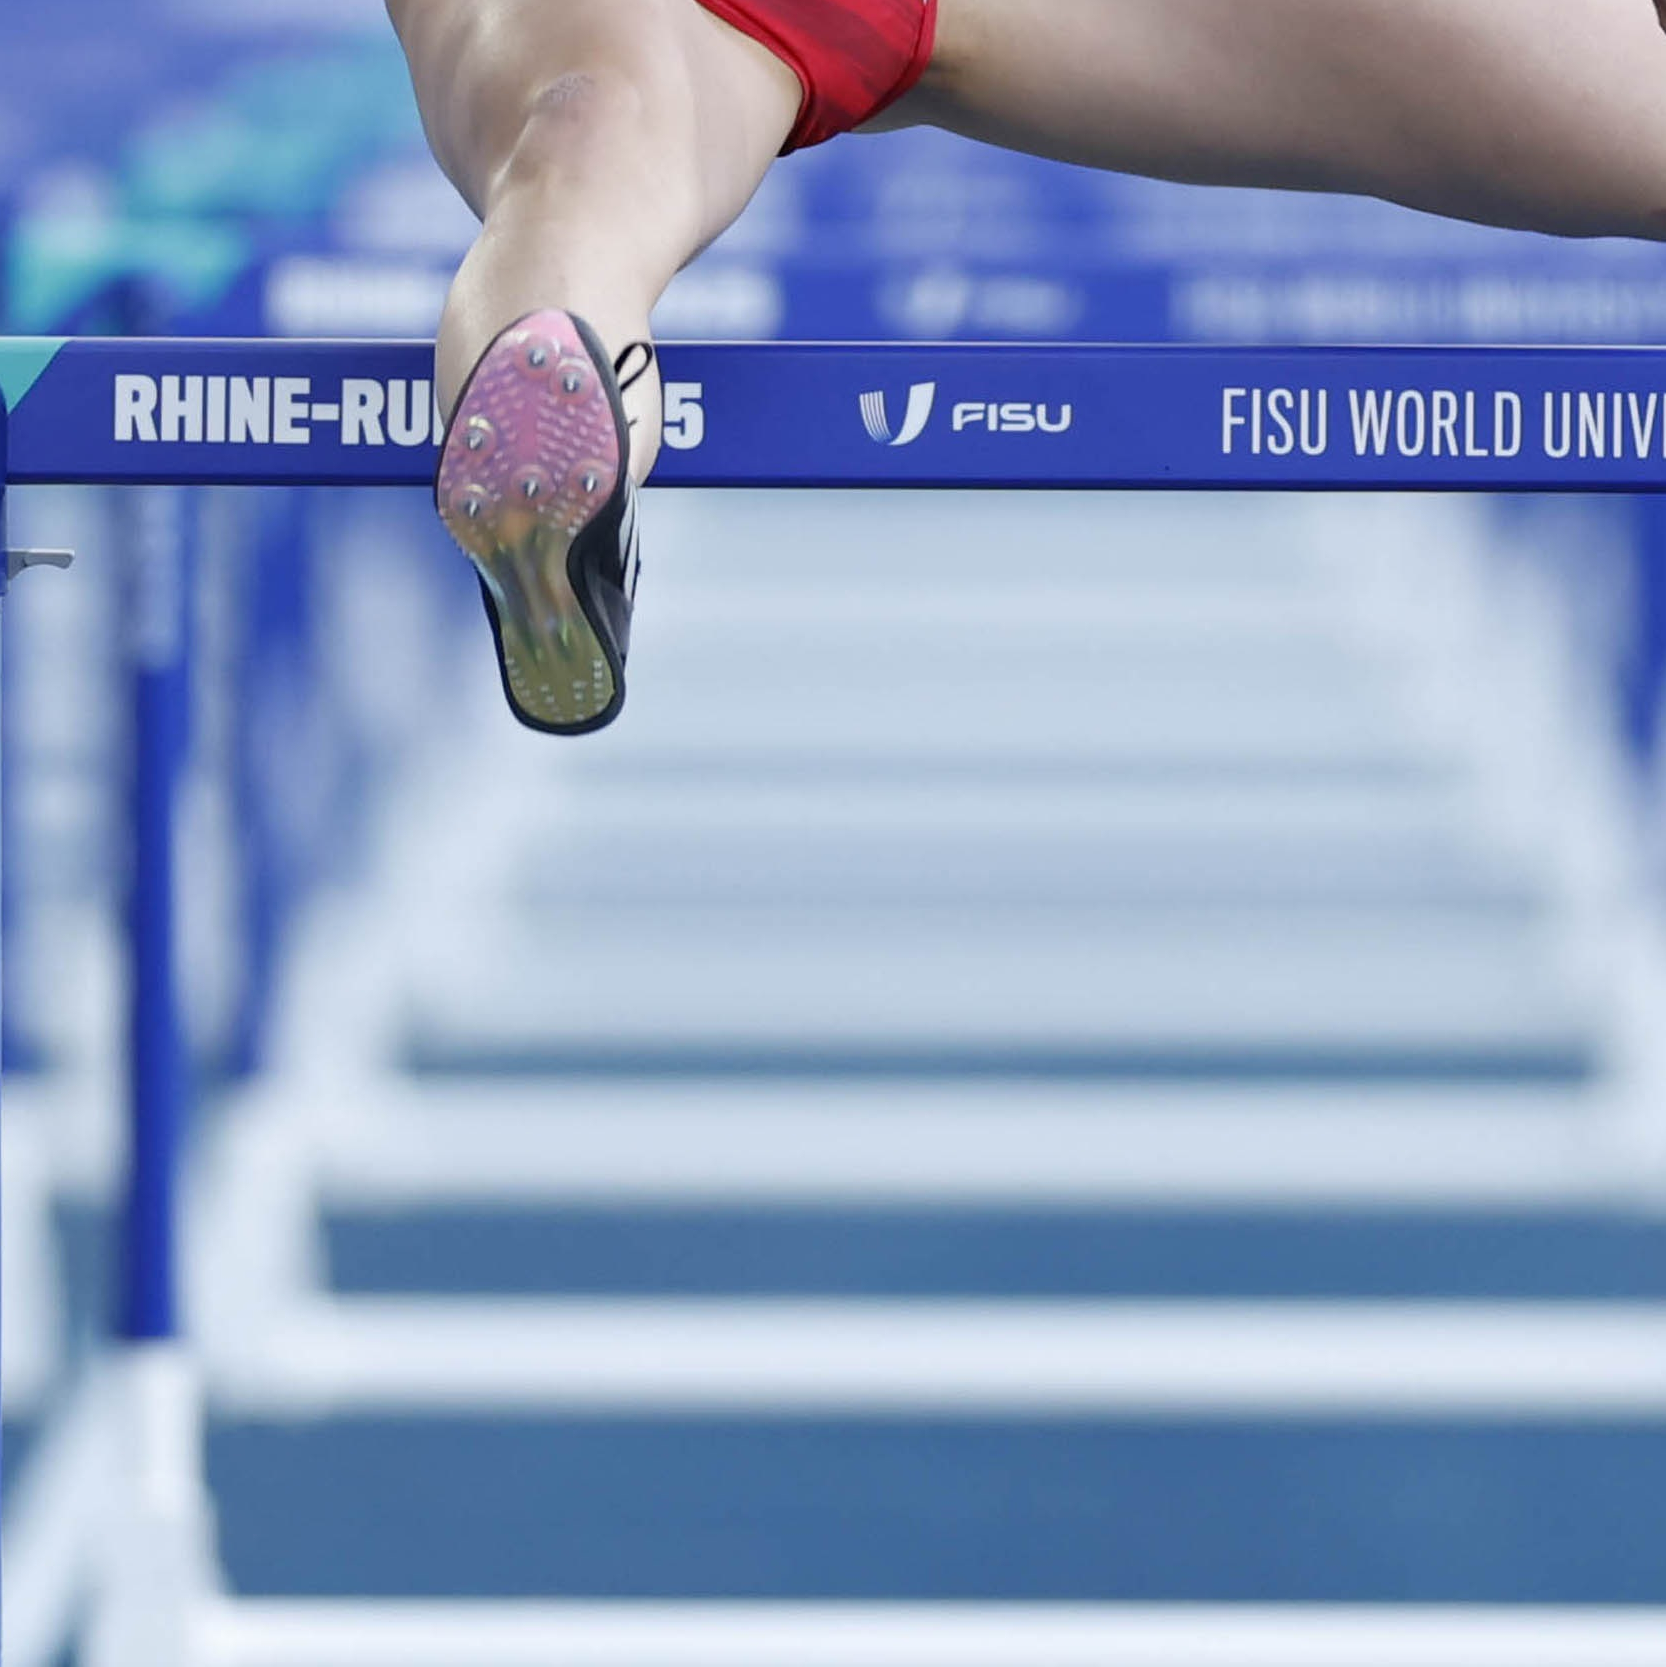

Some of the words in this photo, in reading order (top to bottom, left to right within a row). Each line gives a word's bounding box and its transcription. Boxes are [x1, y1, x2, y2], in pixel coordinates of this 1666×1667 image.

[113, 375, 444, 446] RHINE-RU
[951, 402, 1072, 432] FISU
[1221, 387, 1328, 456] FISU
[1347, 389, 1522, 457] WORLD
